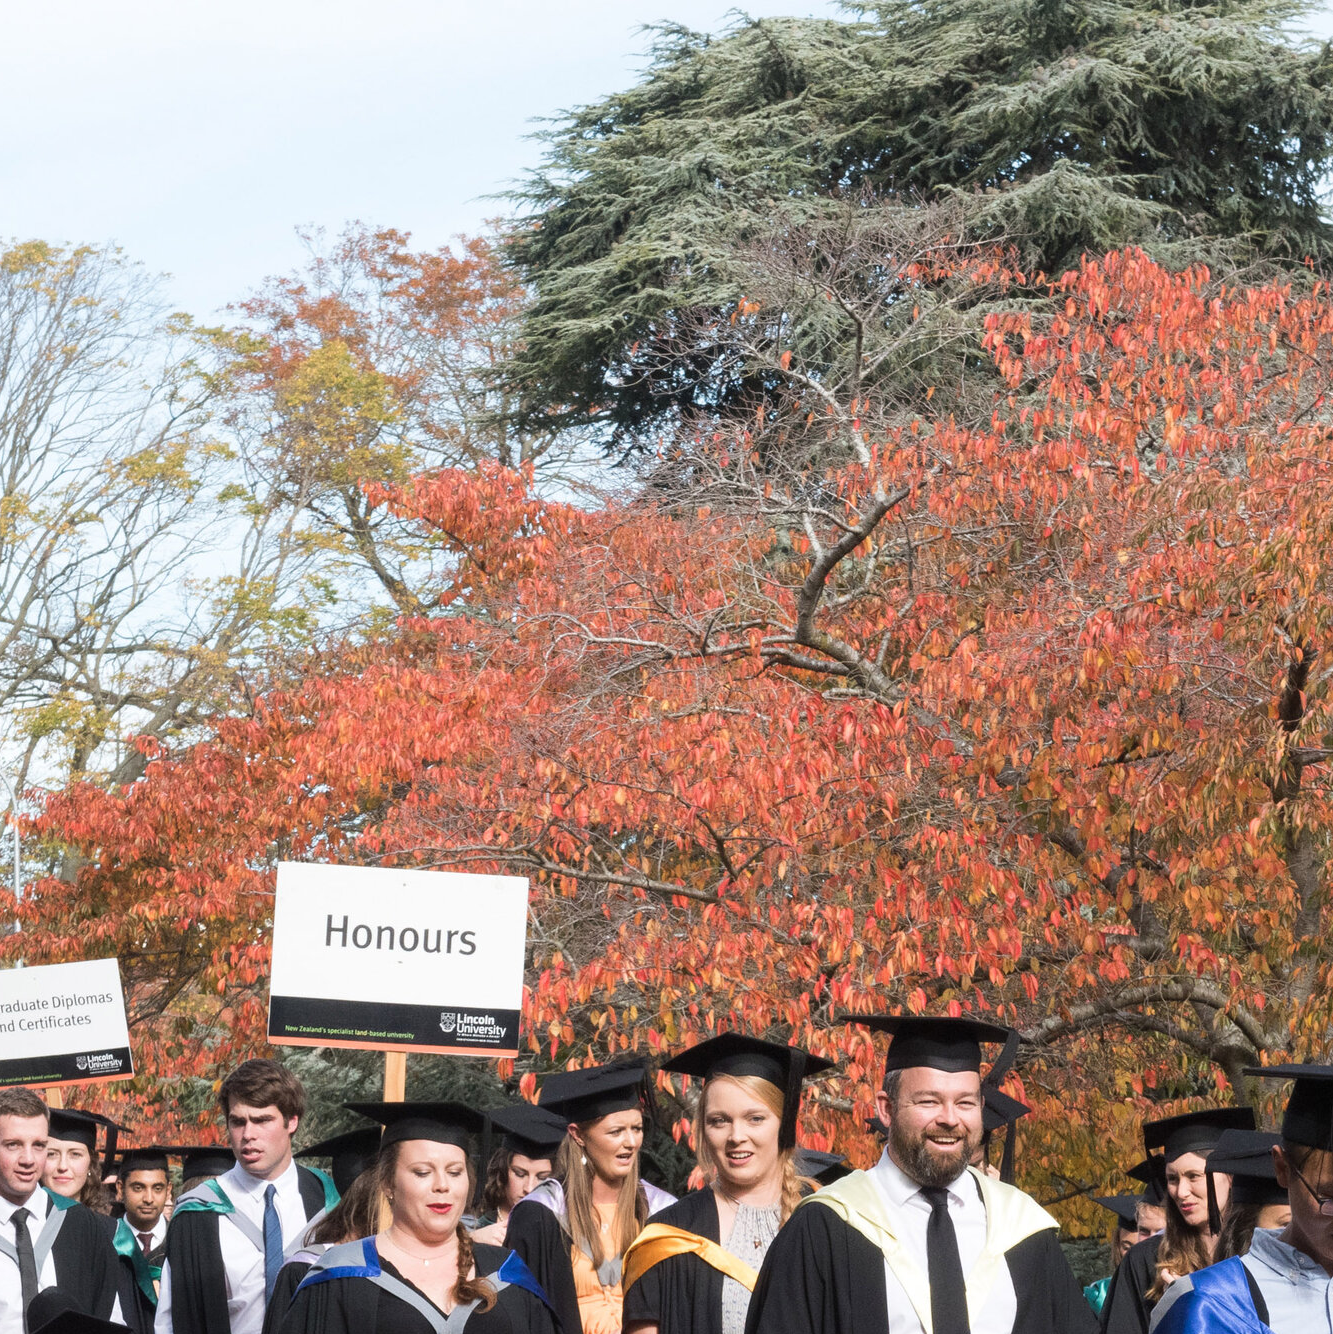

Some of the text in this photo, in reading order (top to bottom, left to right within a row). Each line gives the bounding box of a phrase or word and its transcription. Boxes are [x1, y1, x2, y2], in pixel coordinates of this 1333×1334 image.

[325, 914, 477, 956] Honours
[51, 993, 113, 1011] Diplomas
[18, 1015, 92, 1032] Certificates
[457, 1013, 495, 1025] Lincoln
[327, 1028, 354, 1036] specialist
[456, 1024, 507, 1038] University
[87, 1053, 114, 1063] Lincoln
[87, 1059, 123, 1069] University
